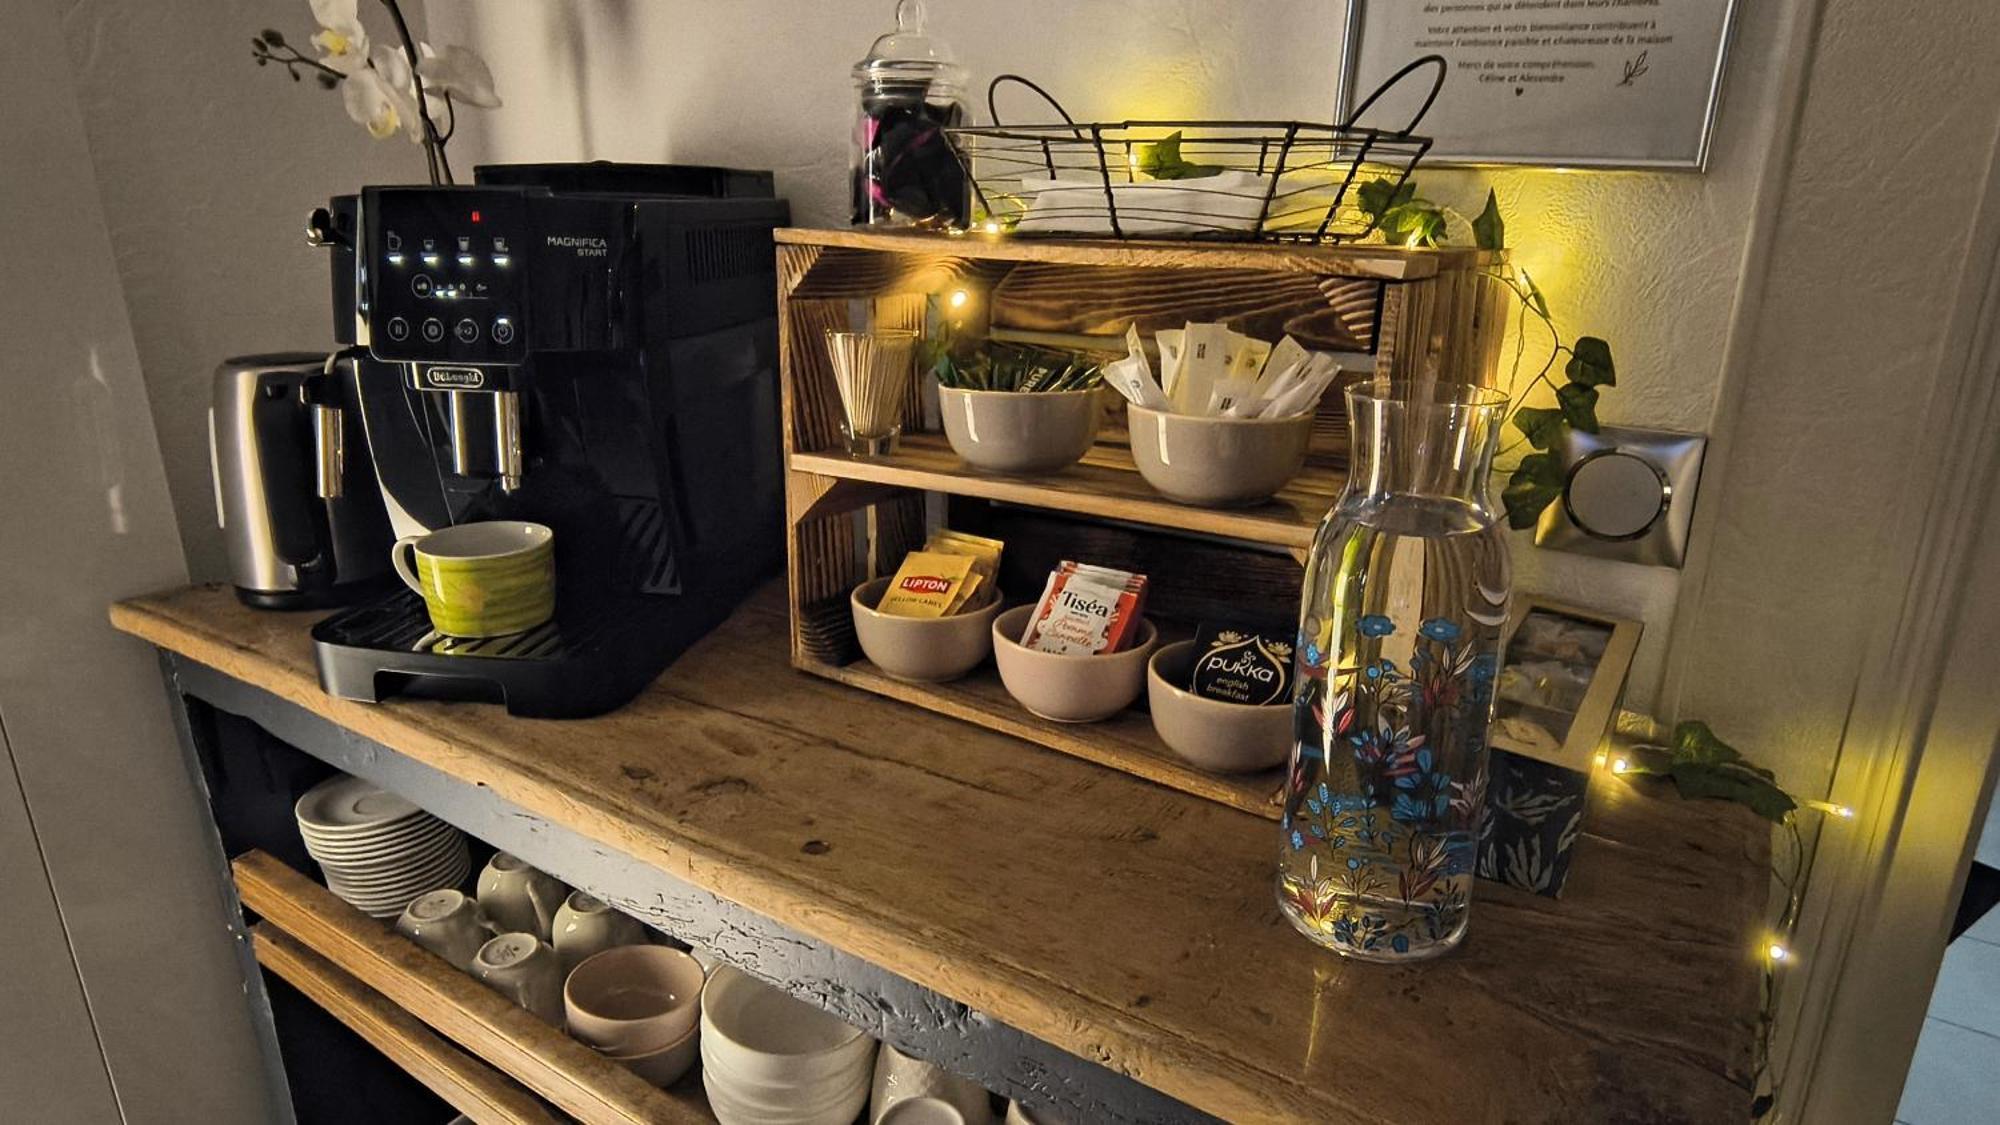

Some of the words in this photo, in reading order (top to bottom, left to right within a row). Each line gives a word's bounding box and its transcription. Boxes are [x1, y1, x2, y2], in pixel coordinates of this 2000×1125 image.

[1424, 3, 1438, 12] des
[1440, 5, 1484, 13] personnes
[1487, 4, 1501, 12] qui
[1428, 26, 1449, 34] Votre
[1451, 25, 1490, 34] attention
[1530, 23, 1589, 32] bienveillance
[1591, 21, 1648, 31] contribuent
[1504, 37, 1539, 48] paisible
[1542, 37, 1552, 45] et
[1611, 35, 1623, 43] de
[1458, 61, 1481, 70] Merci
[1483, 61, 1494, 69] de
[1479, 73, 1505, 82] Céline
[1520, 74, 1564, 82] Alexandre
[547, 236, 607, 248] MAGNIFICA
[577, 249, 607, 257] START
[903, 578, 948, 591] LIPTON
[1063, 590, 1108, 617] Tiséa
[1206, 656, 1274, 683] pukka
[1216, 677, 1249, 690] english
[1206, 683, 1249, 701] breakfast
